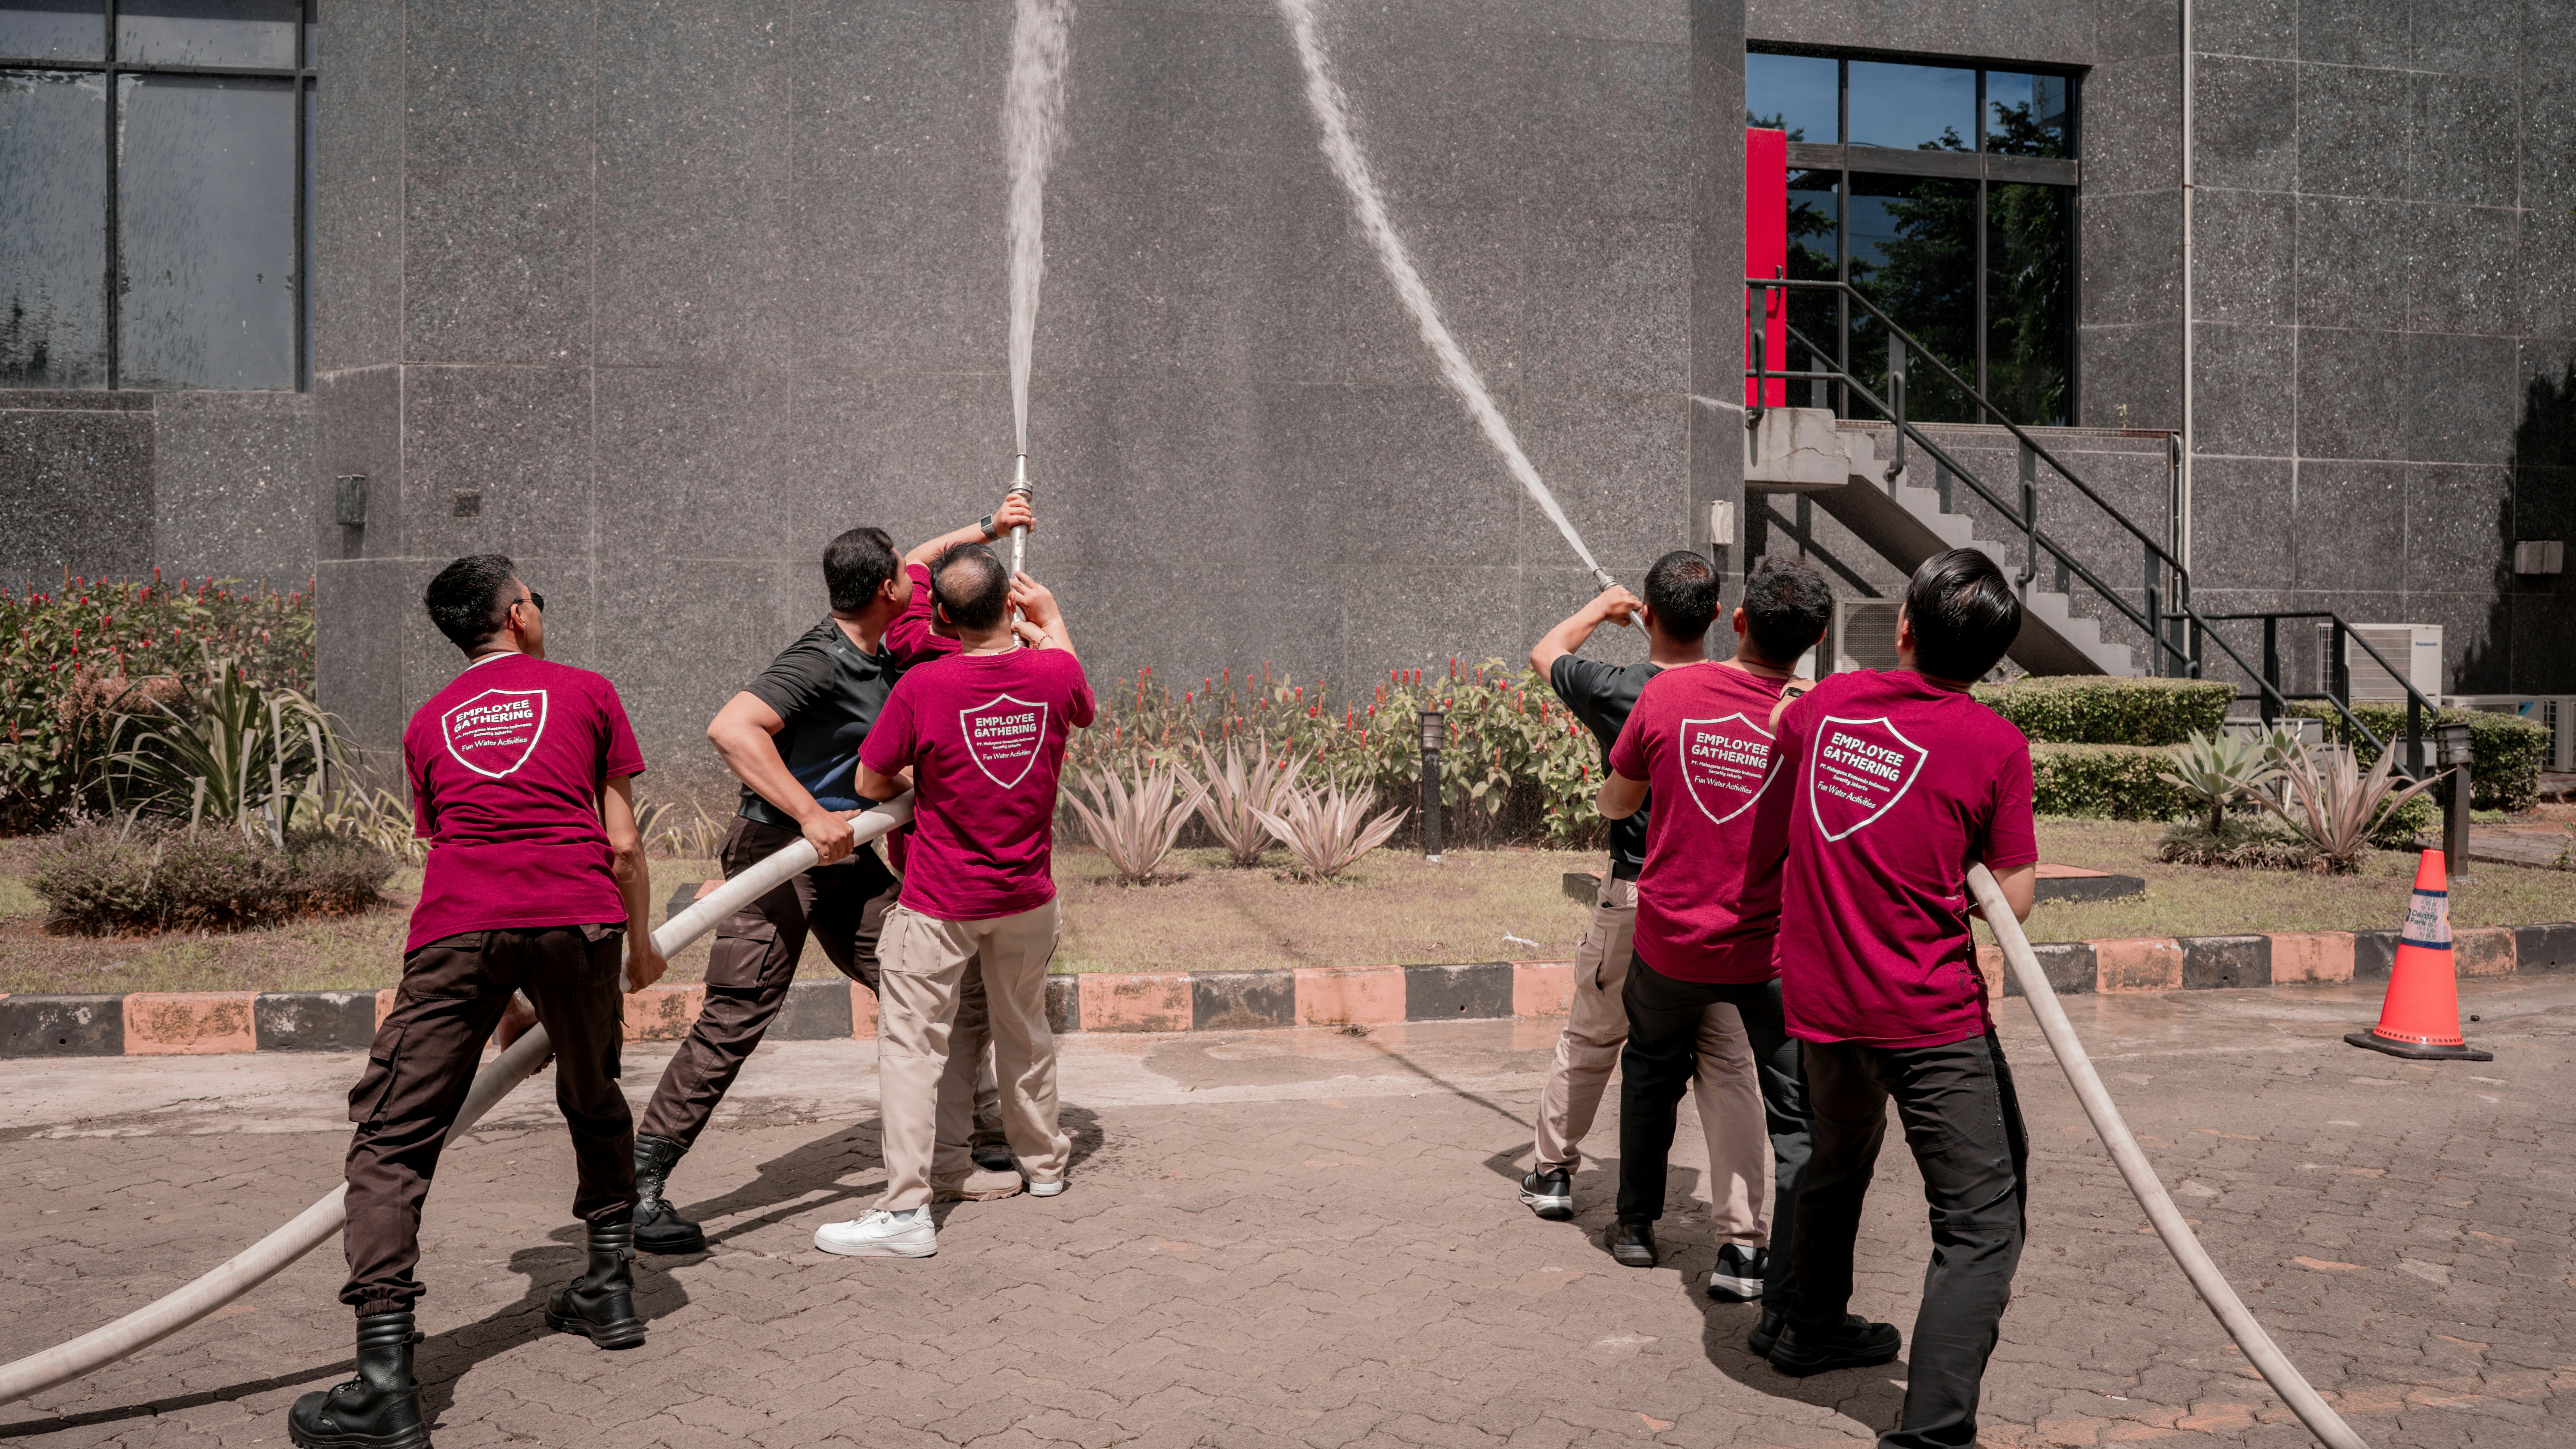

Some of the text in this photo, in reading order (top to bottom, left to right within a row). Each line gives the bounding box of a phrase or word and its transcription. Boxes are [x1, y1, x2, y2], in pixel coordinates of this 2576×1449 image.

[454, 710, 533, 732] GATHERING
[456, 699, 530, 723] EMPLOYEE
[976, 713, 1035, 727] EMPLOYEE
[497, 736, 527, 746] Activities
[974, 723, 1036, 738] GATHERING
[1696, 732, 1769, 756] EMPLOYEE
[1831, 732, 1905, 767] EMPLOYEE
[1691, 745, 1768, 769] GATHERING
[1823, 746, 1900, 782] GATHERING
[1694, 776, 1752, 794] Fun Water Activities
[1741, 770, 1762, 779] Indonesia
[1827, 765, 1847, 777] Mahaguna
[1848, 773, 1868, 785] Komando
[1868, 780, 1890, 792] Indonesia
[1833, 775, 1868, 791] Security Jakarta
[1817, 781, 1876, 809] Fun Water Activities
[2410, 917, 2426, 926] Park
